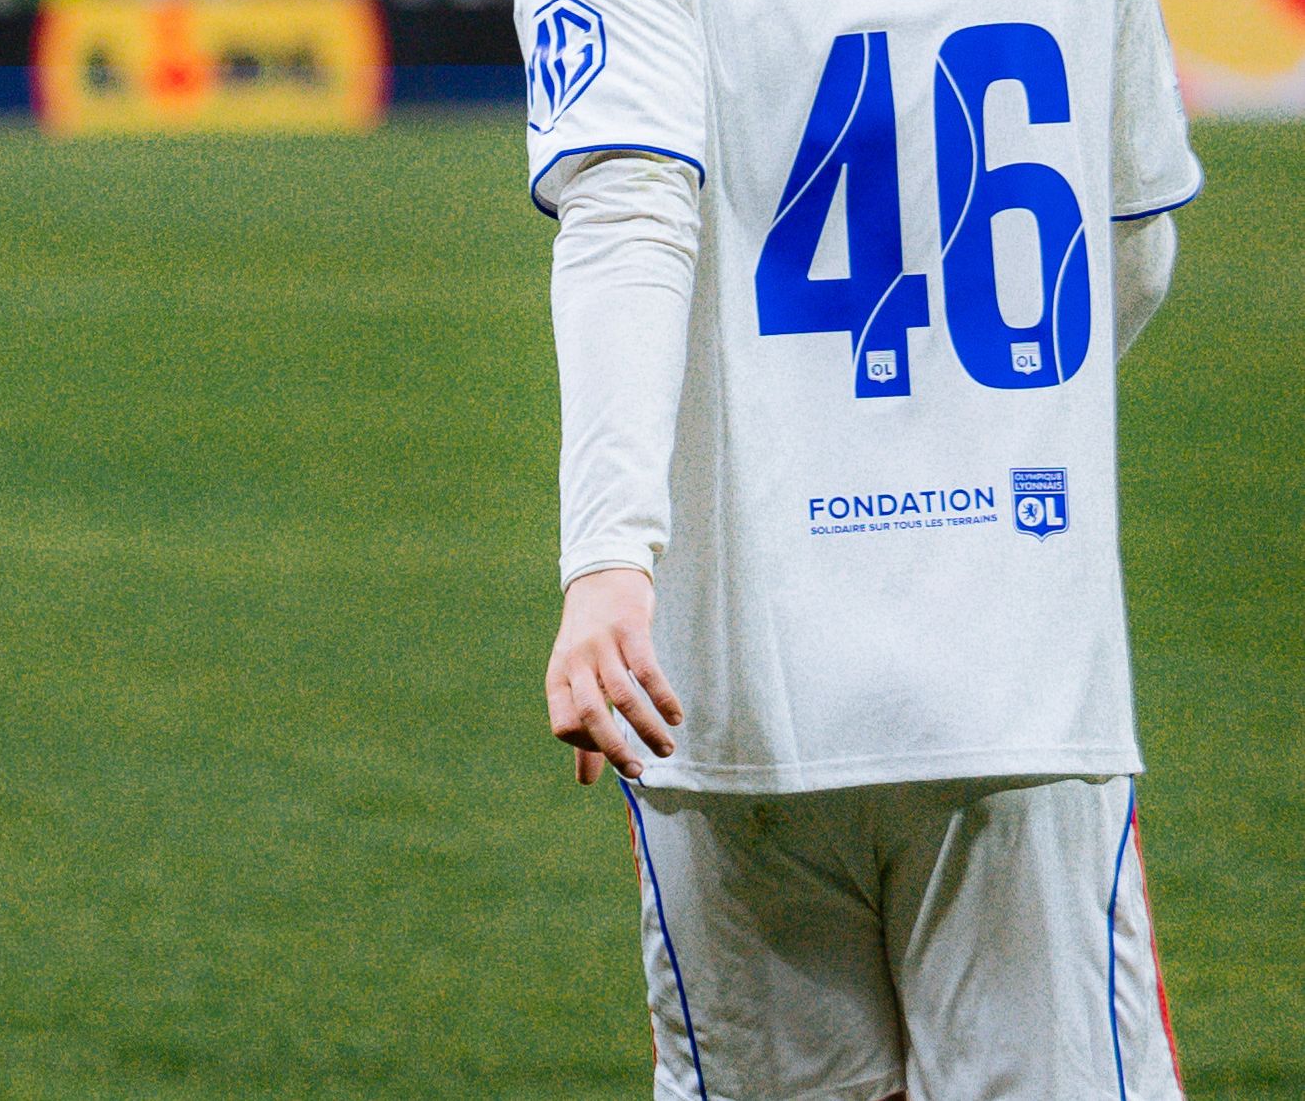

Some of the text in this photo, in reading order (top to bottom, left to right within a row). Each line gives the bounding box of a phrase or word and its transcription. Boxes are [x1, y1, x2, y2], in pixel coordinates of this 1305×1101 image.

[755, 22, 1091, 398] 46
[1014, 481, 1063, 490] LYONNAIS
[809, 486, 995, 520] FONDATION
[1017, 496, 1063, 527] OL
[810, 513, 998, 535] SOLIDAIRE SUR TOUS LES TERRAINS
